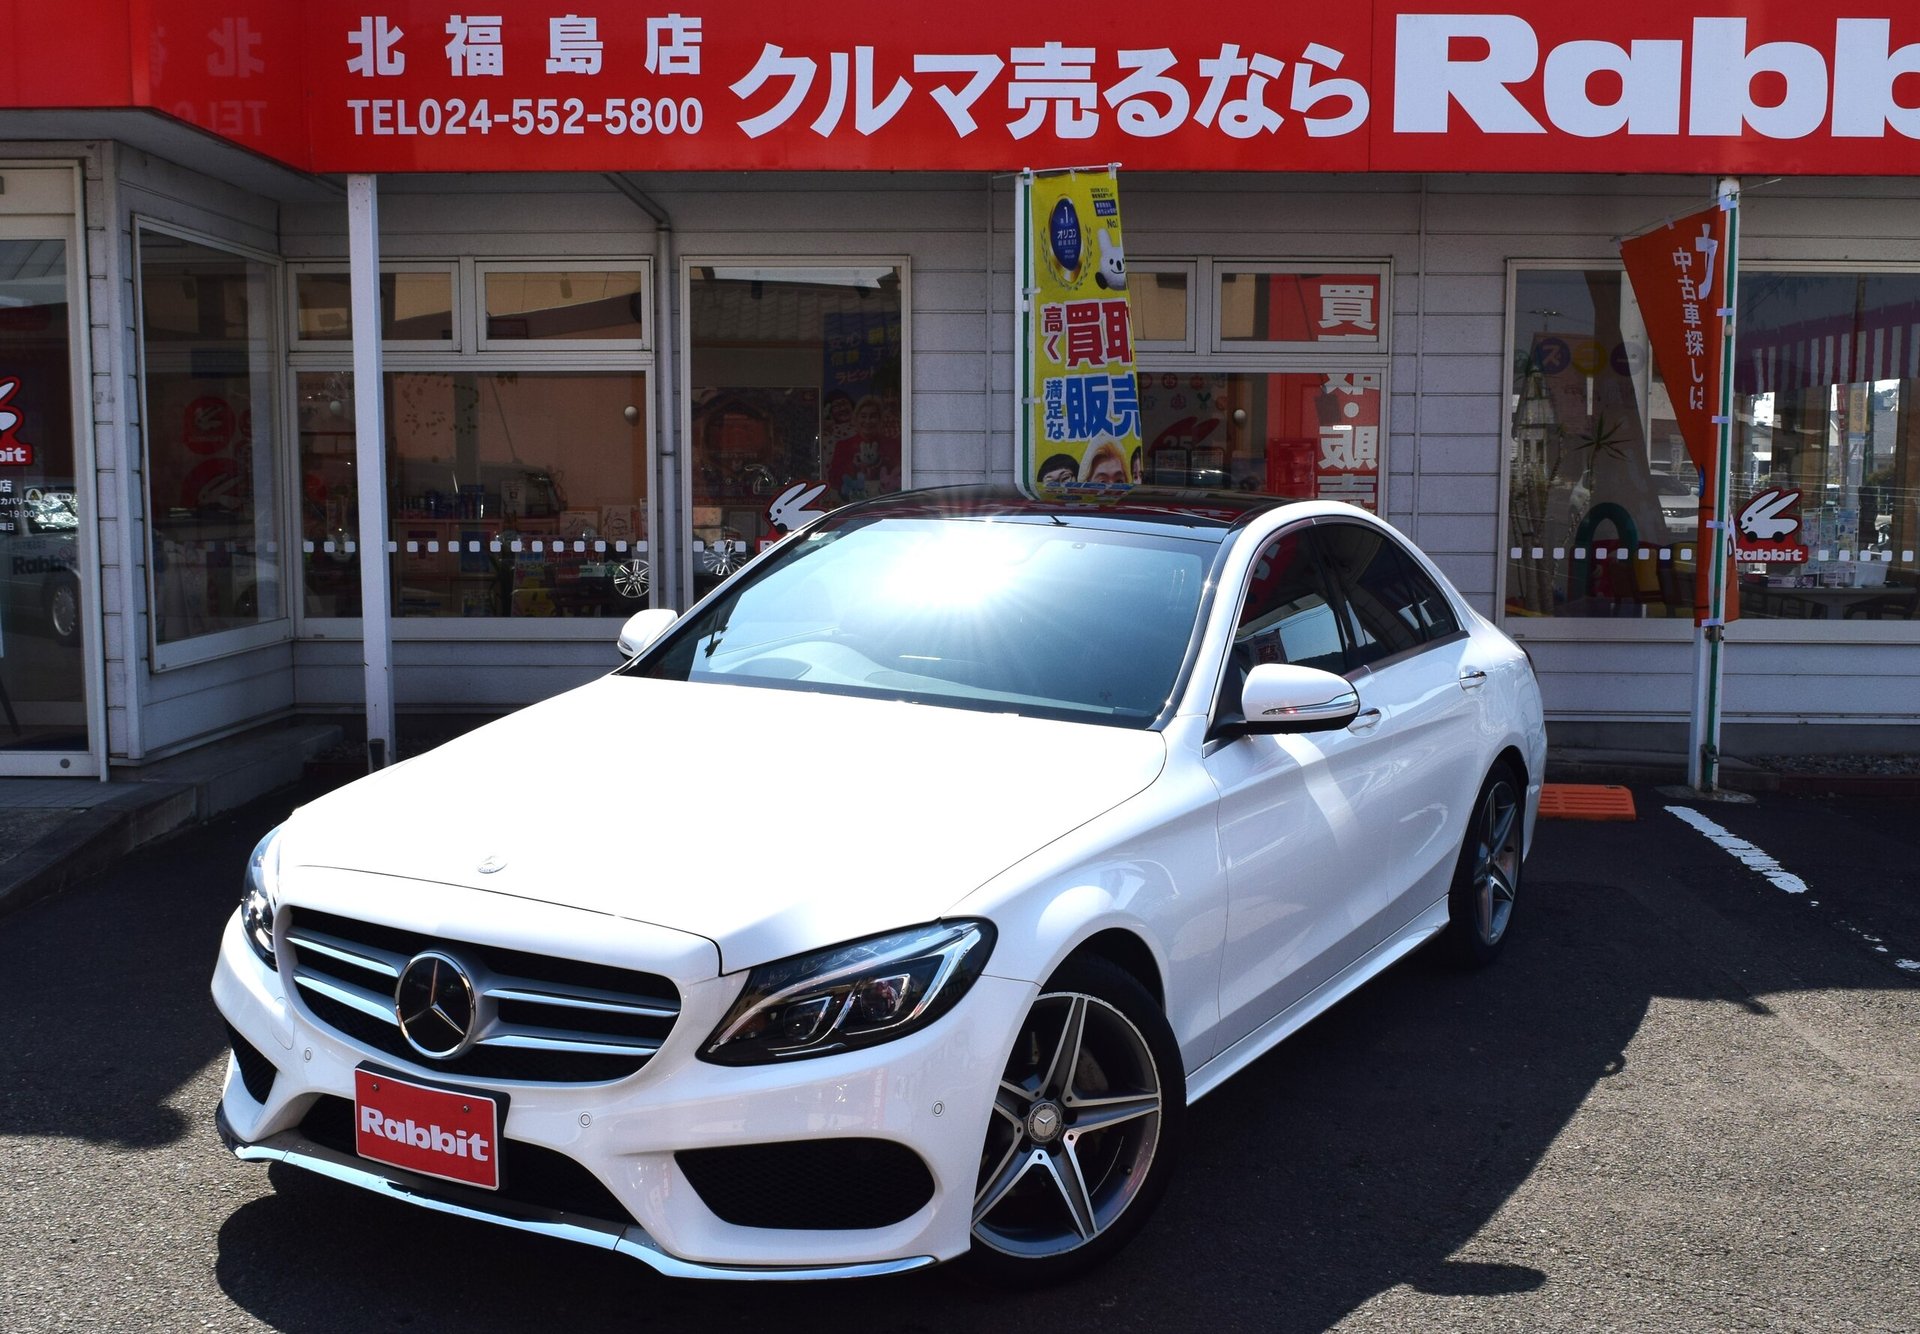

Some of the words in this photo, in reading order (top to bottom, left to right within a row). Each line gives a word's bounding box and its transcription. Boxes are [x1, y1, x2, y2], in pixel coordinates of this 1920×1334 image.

[347, 14, 702, 76] 北福島店
[347, 98, 703, 136] TEL024-552-5800
[729, 41, 1370, 139] クルマ売るなら
[1044, 306, 1063, 361] 高く
[1672, 246, 1705, 411] 中古車探しは
[1045, 379, 1064, 440] 満足な
[361, 1105, 489, 1162] Rabbit
